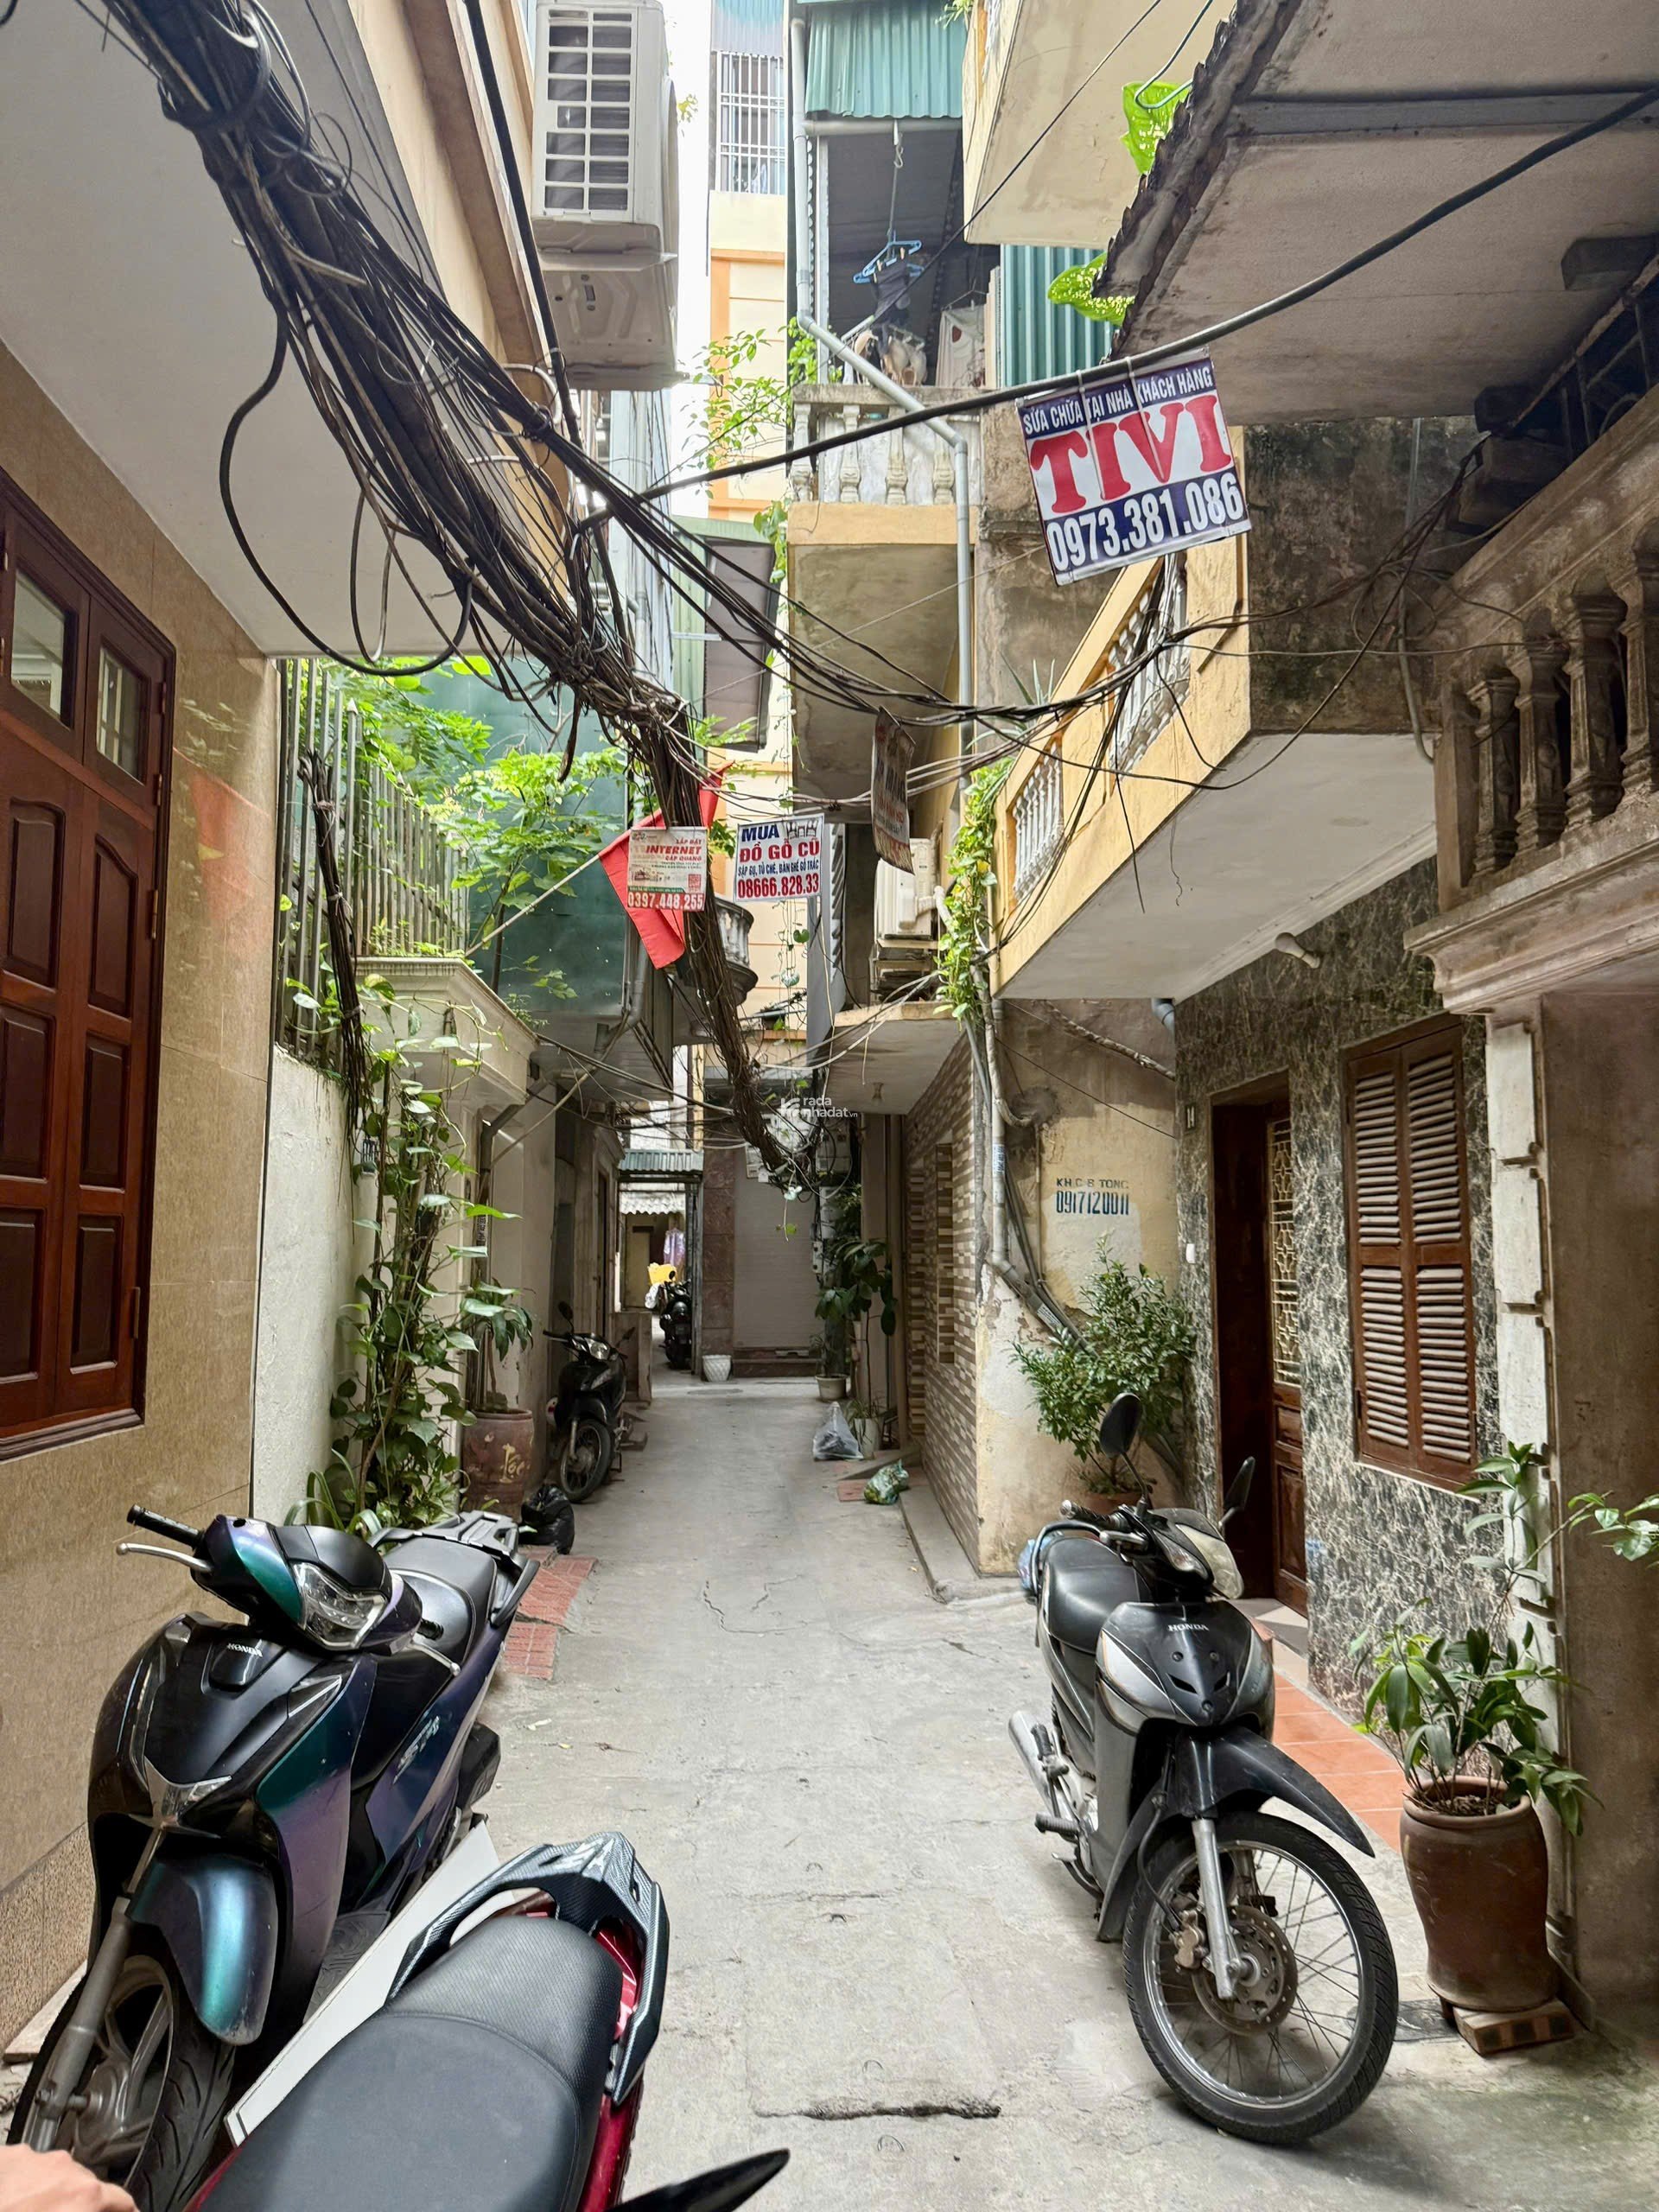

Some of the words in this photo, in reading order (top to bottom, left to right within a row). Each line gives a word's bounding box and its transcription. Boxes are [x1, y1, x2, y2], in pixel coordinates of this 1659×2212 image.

[1050, 397, 1084, 429] CHỮA
[1106, 385, 1134, 414] NHÀ
[1135, 376, 1177, 405] KHÁCH
[1178, 366, 1213, 394] HÀNG
[1029, 393, 1233, 515] TIVI
[1046, 472, 1245, 572] 0973.381.086
[741, 823, 779, 842] MUA
[646, 846, 702, 855] INTERNET
[740, 842, 763, 862] ĐỒ
[768, 837, 792, 861] GỖ
[798, 836, 820, 858] CŨ
[738, 874, 819, 899] 08666.828.33
[628, 892, 704, 911] 0397.448.255
[1056, 1190, 1129, 1216] 0917120011
[226, 1643, 264, 1658] HONDA
